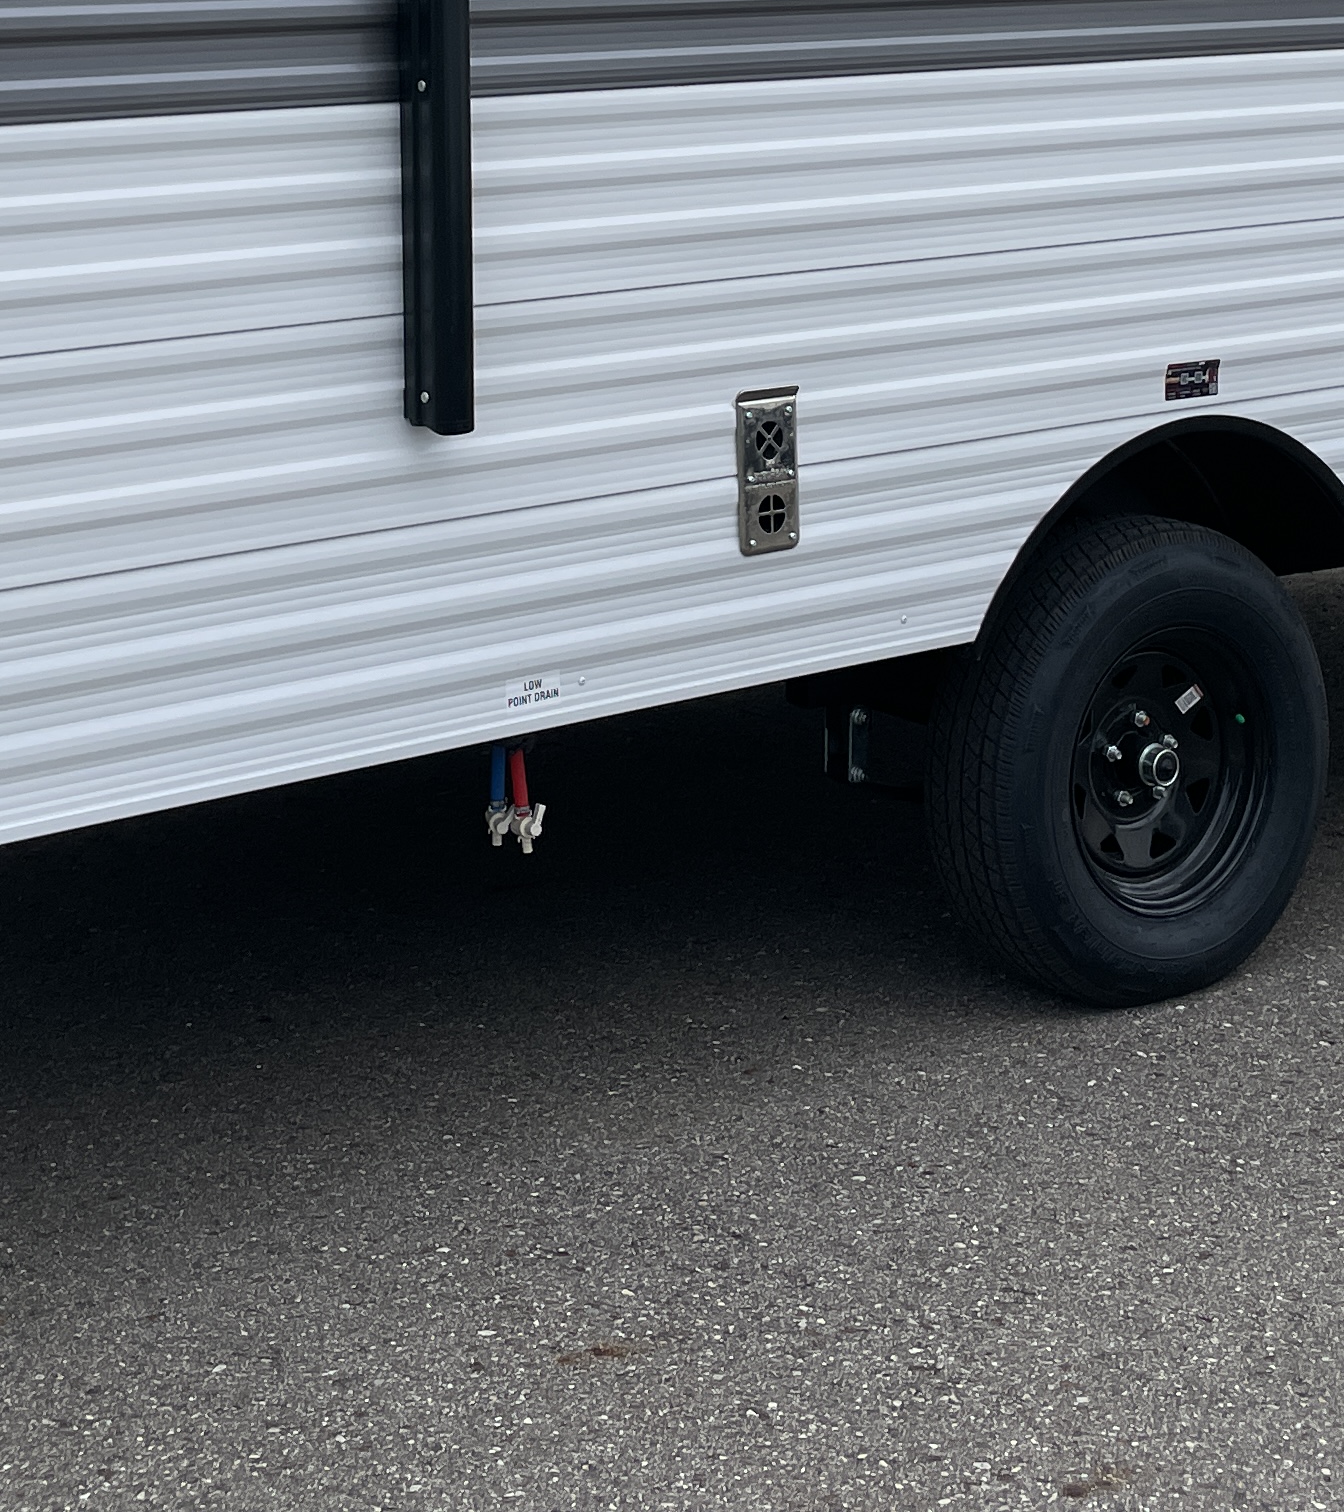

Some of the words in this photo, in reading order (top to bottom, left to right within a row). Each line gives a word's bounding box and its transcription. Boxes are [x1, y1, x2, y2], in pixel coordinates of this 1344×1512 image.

[524, 679, 542, 691] LOW
[508, 694, 532, 708] POINT
[535, 688, 559, 702] DRAIN
